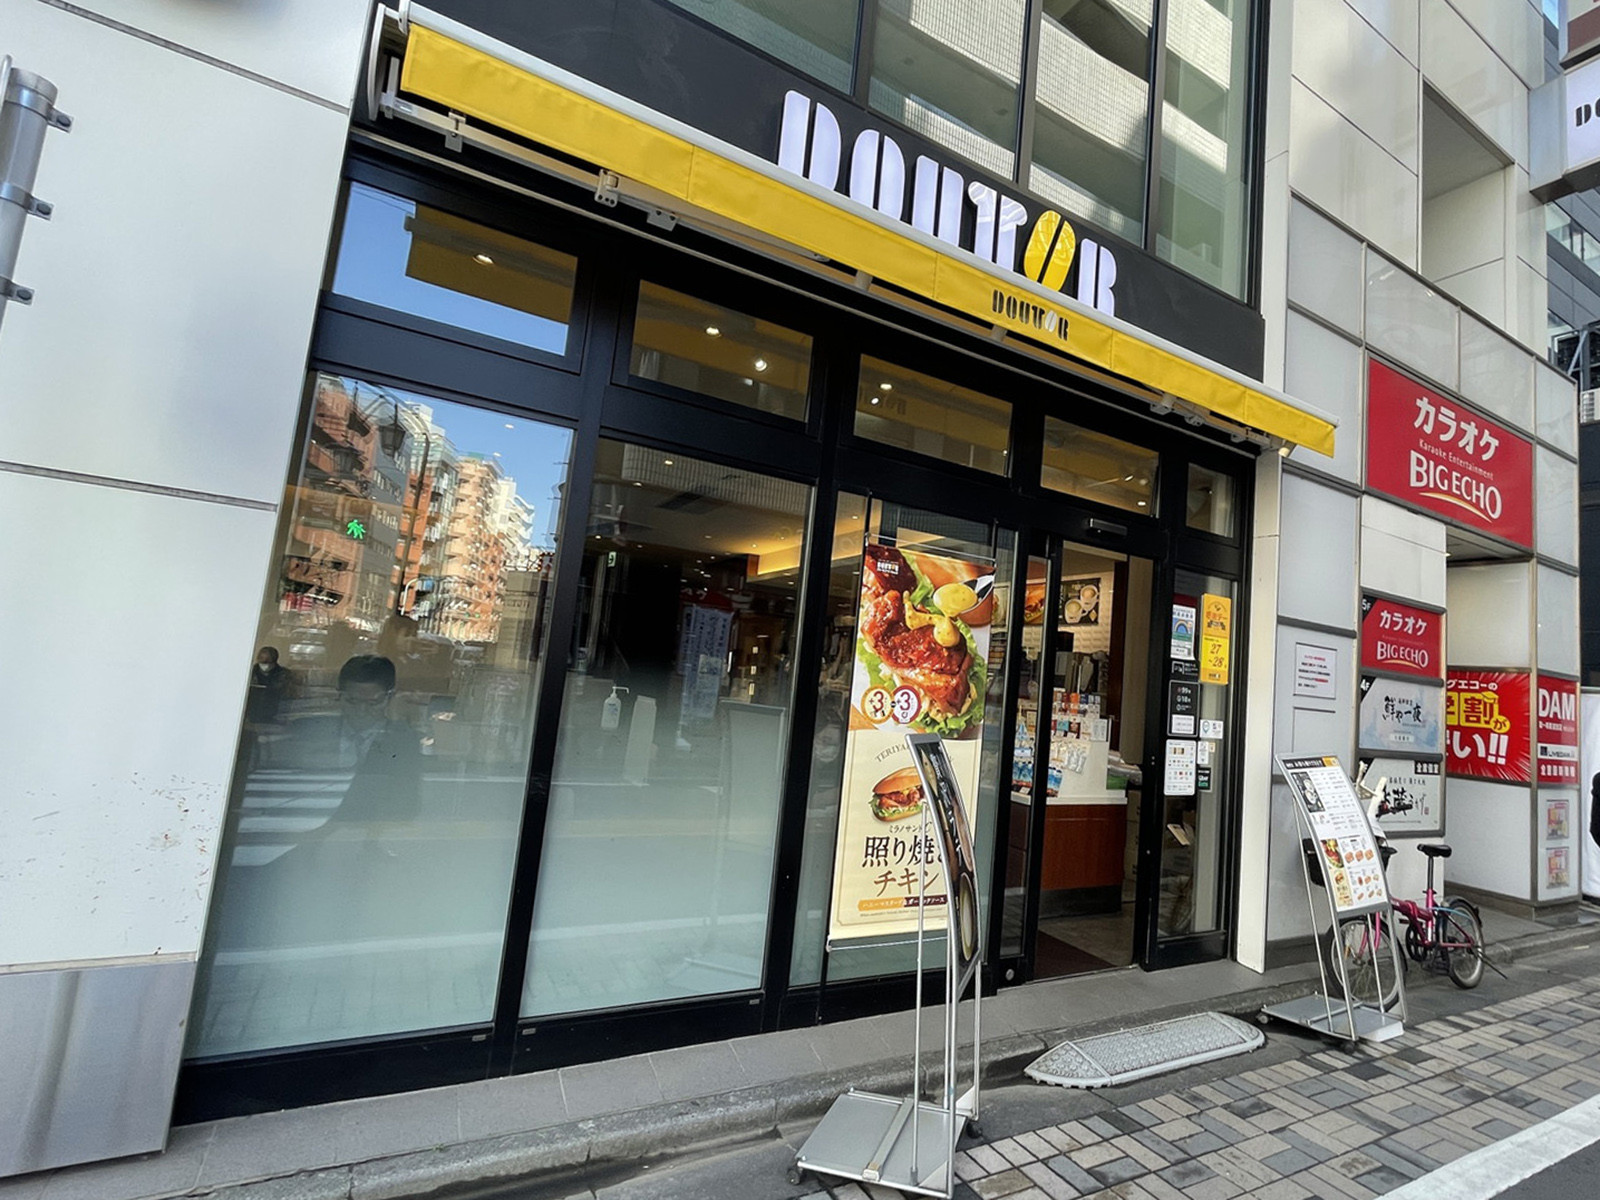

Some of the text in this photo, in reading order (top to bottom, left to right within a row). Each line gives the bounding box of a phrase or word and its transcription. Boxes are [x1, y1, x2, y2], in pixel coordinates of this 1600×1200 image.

[777, 89, 1118, 318] DOUTOR
[992, 289, 1070, 341] DOUTOR
[1413, 396, 1499, 461] カラオケ
[1419, 438, 1494, 481] Karaoke Entertainment
[1409, 449, 1502, 519] BIG ECHO
[1379, 610, 1427, 636] カラオケ
[1377, 641, 1429, 668] BIG ECHO
[1538, 688, 1576, 721] DAM
[862, 835, 944, 868] 照り焼
[873, 867, 940, 897] チキン
